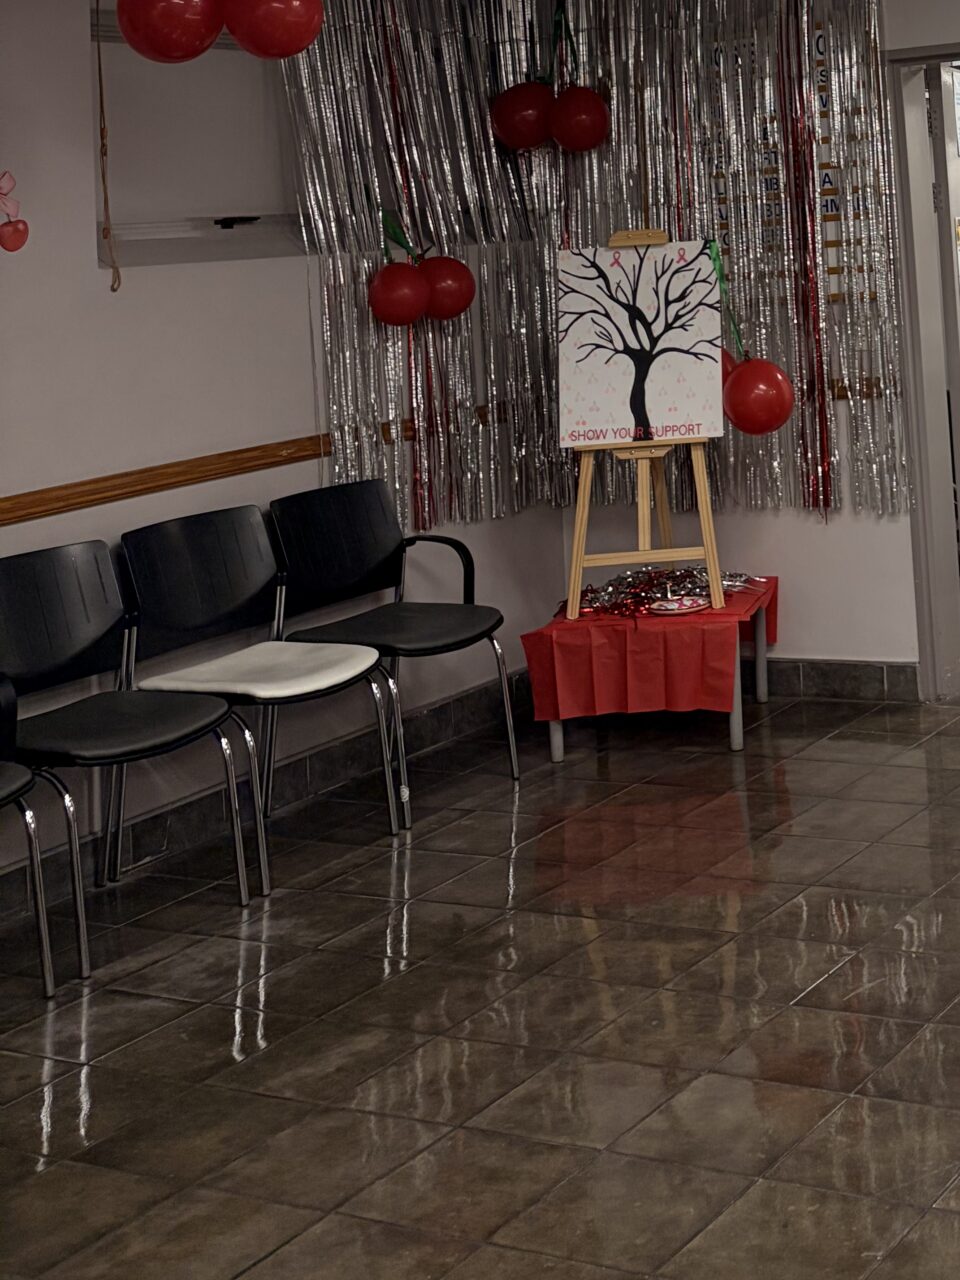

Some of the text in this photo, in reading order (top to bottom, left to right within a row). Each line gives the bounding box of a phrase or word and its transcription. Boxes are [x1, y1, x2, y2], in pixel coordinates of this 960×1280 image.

[570, 423, 702, 441] SHOW YOUR SUPPORT
